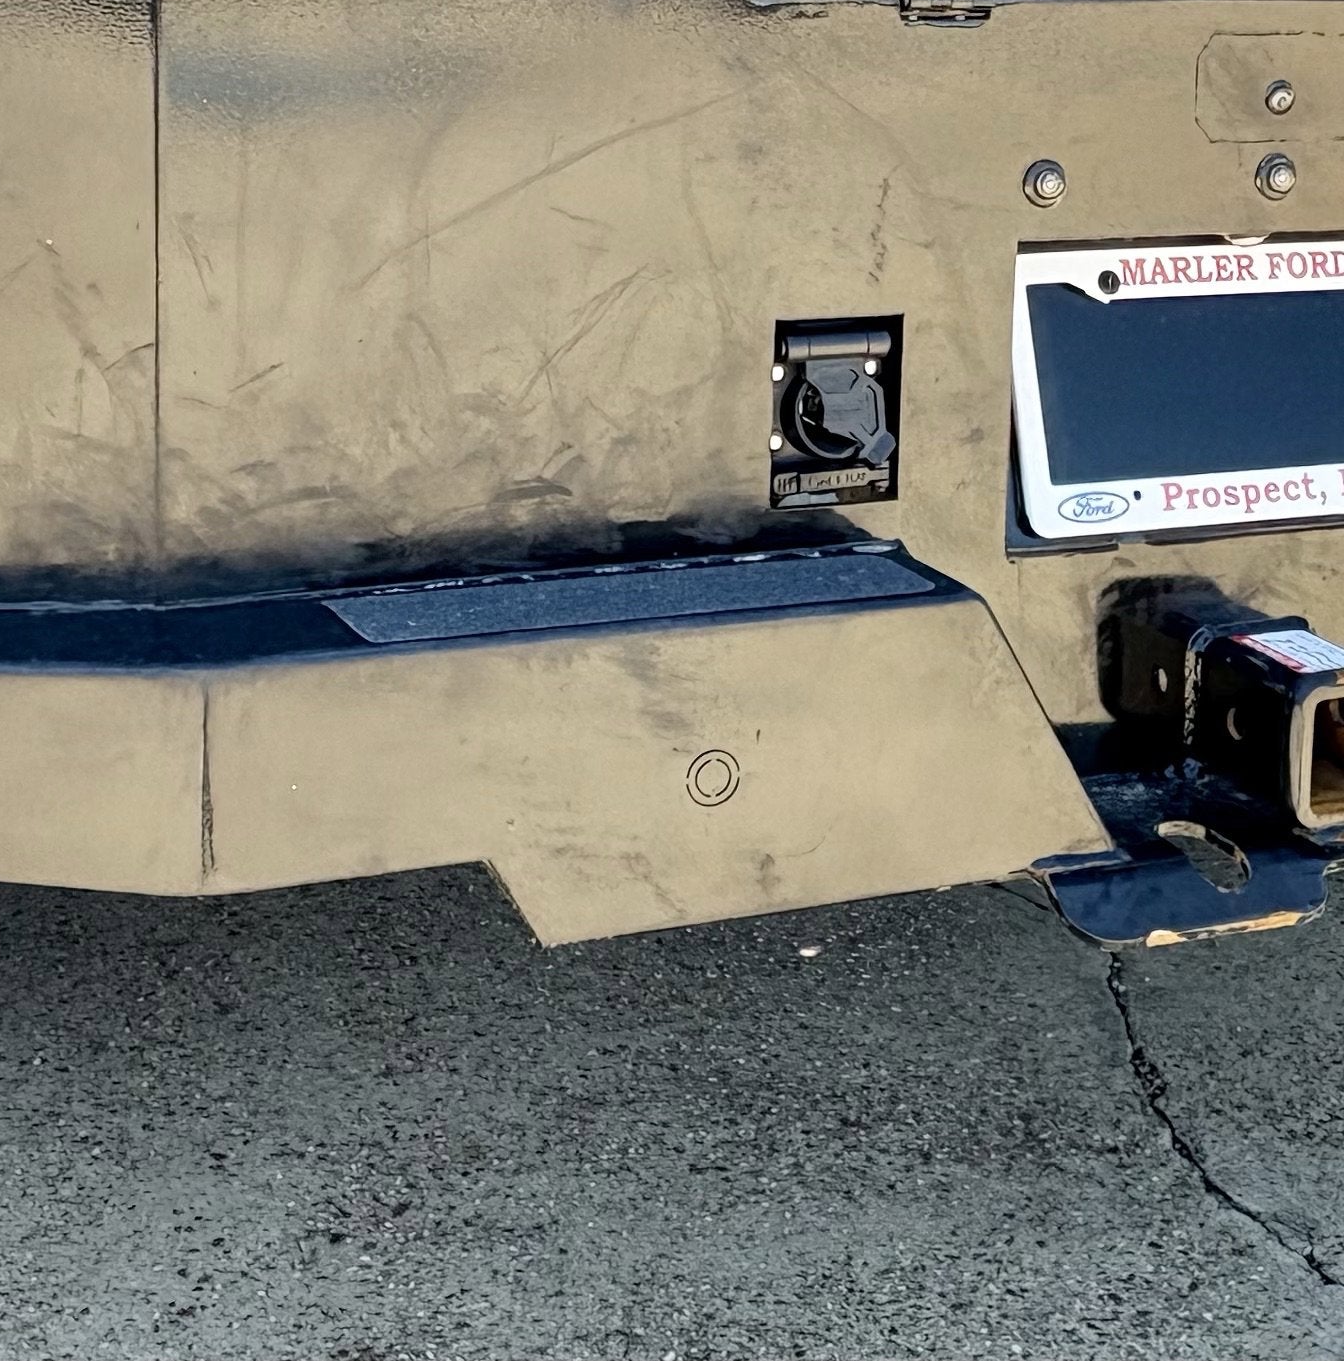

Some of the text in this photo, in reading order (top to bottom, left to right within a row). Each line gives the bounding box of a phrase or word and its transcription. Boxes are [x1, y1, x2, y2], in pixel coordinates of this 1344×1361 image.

[1119, 253, 1258, 286] MARLER
[1072, 496, 1115, 518] Ford
[1160, 472, 1328, 514] Prospect,
